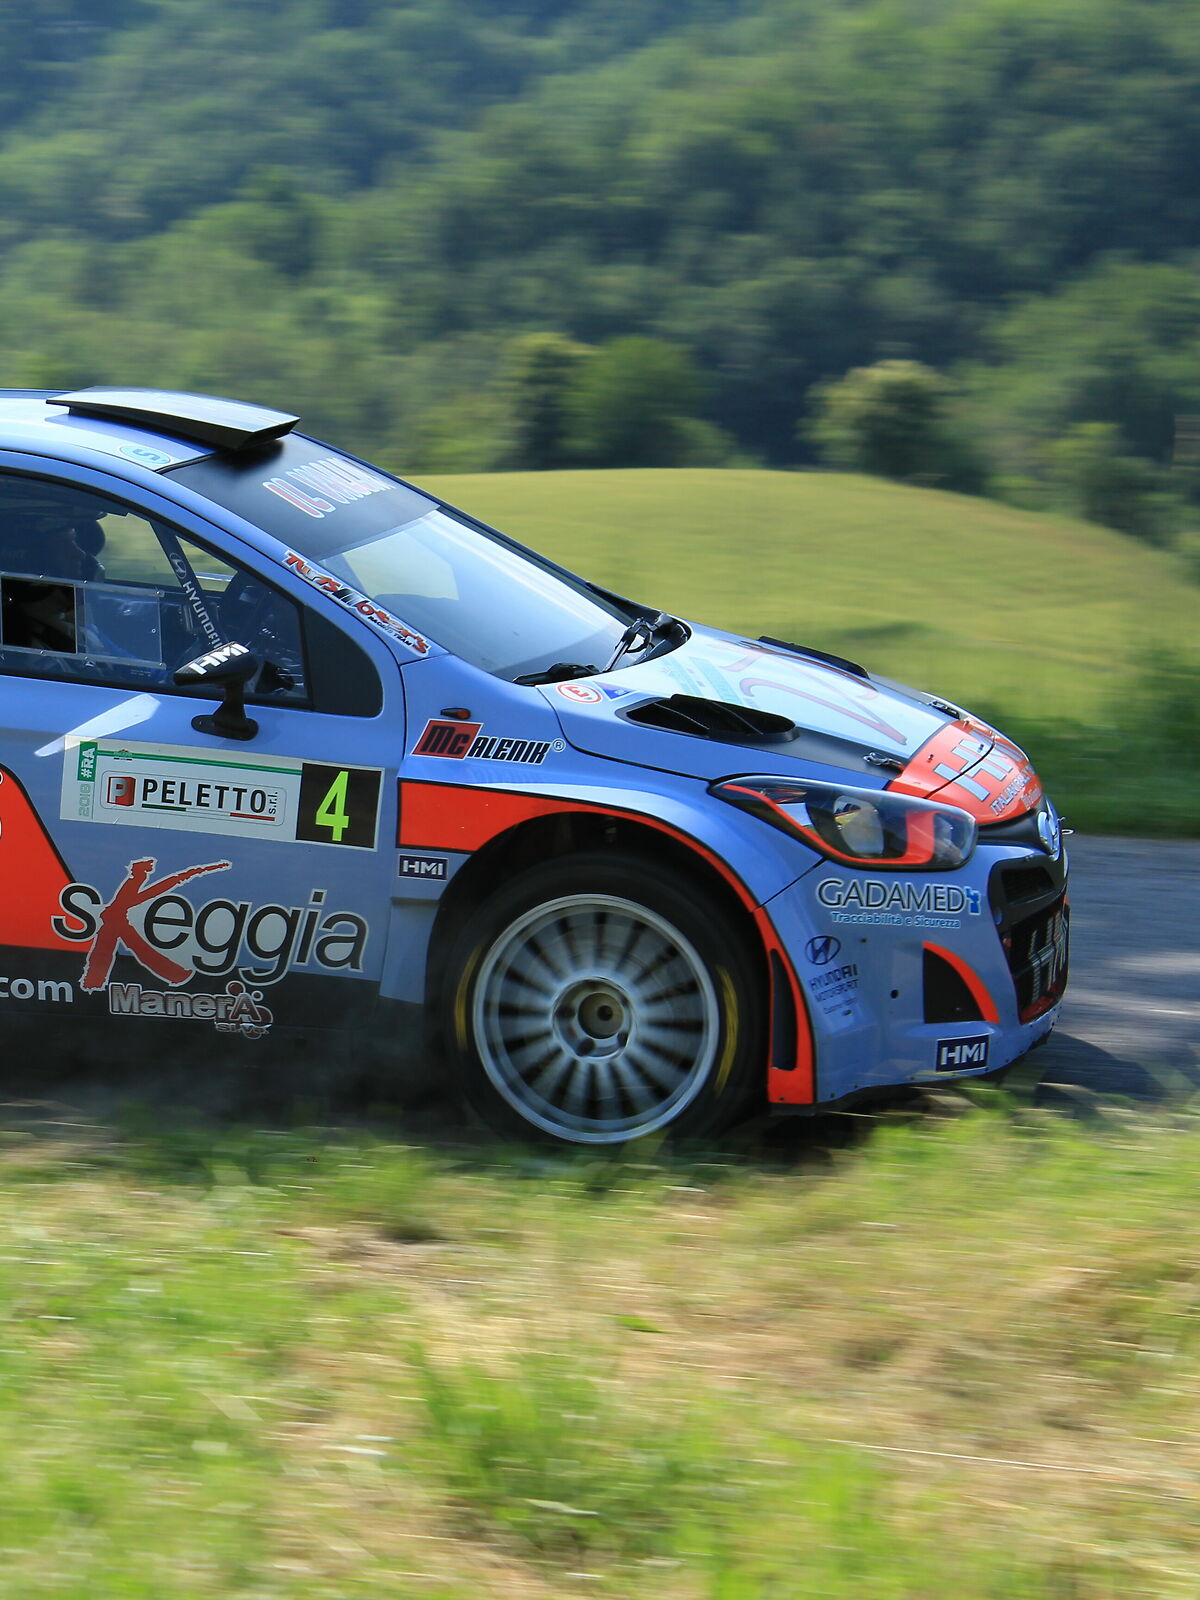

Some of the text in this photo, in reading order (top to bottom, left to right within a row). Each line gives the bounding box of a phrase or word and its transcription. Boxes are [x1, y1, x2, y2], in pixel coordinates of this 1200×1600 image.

[188, 643, 250, 675] HMI
[141, 777, 278, 815] PELETTO s.r.l.
[315, 770, 350, 842] 4
[402, 858, 444, 877] HMI
[817, 878, 967, 913] GADAMED
[915, 914, 961, 928] Sicurezza
[940, 1041, 987, 1067] HMI
